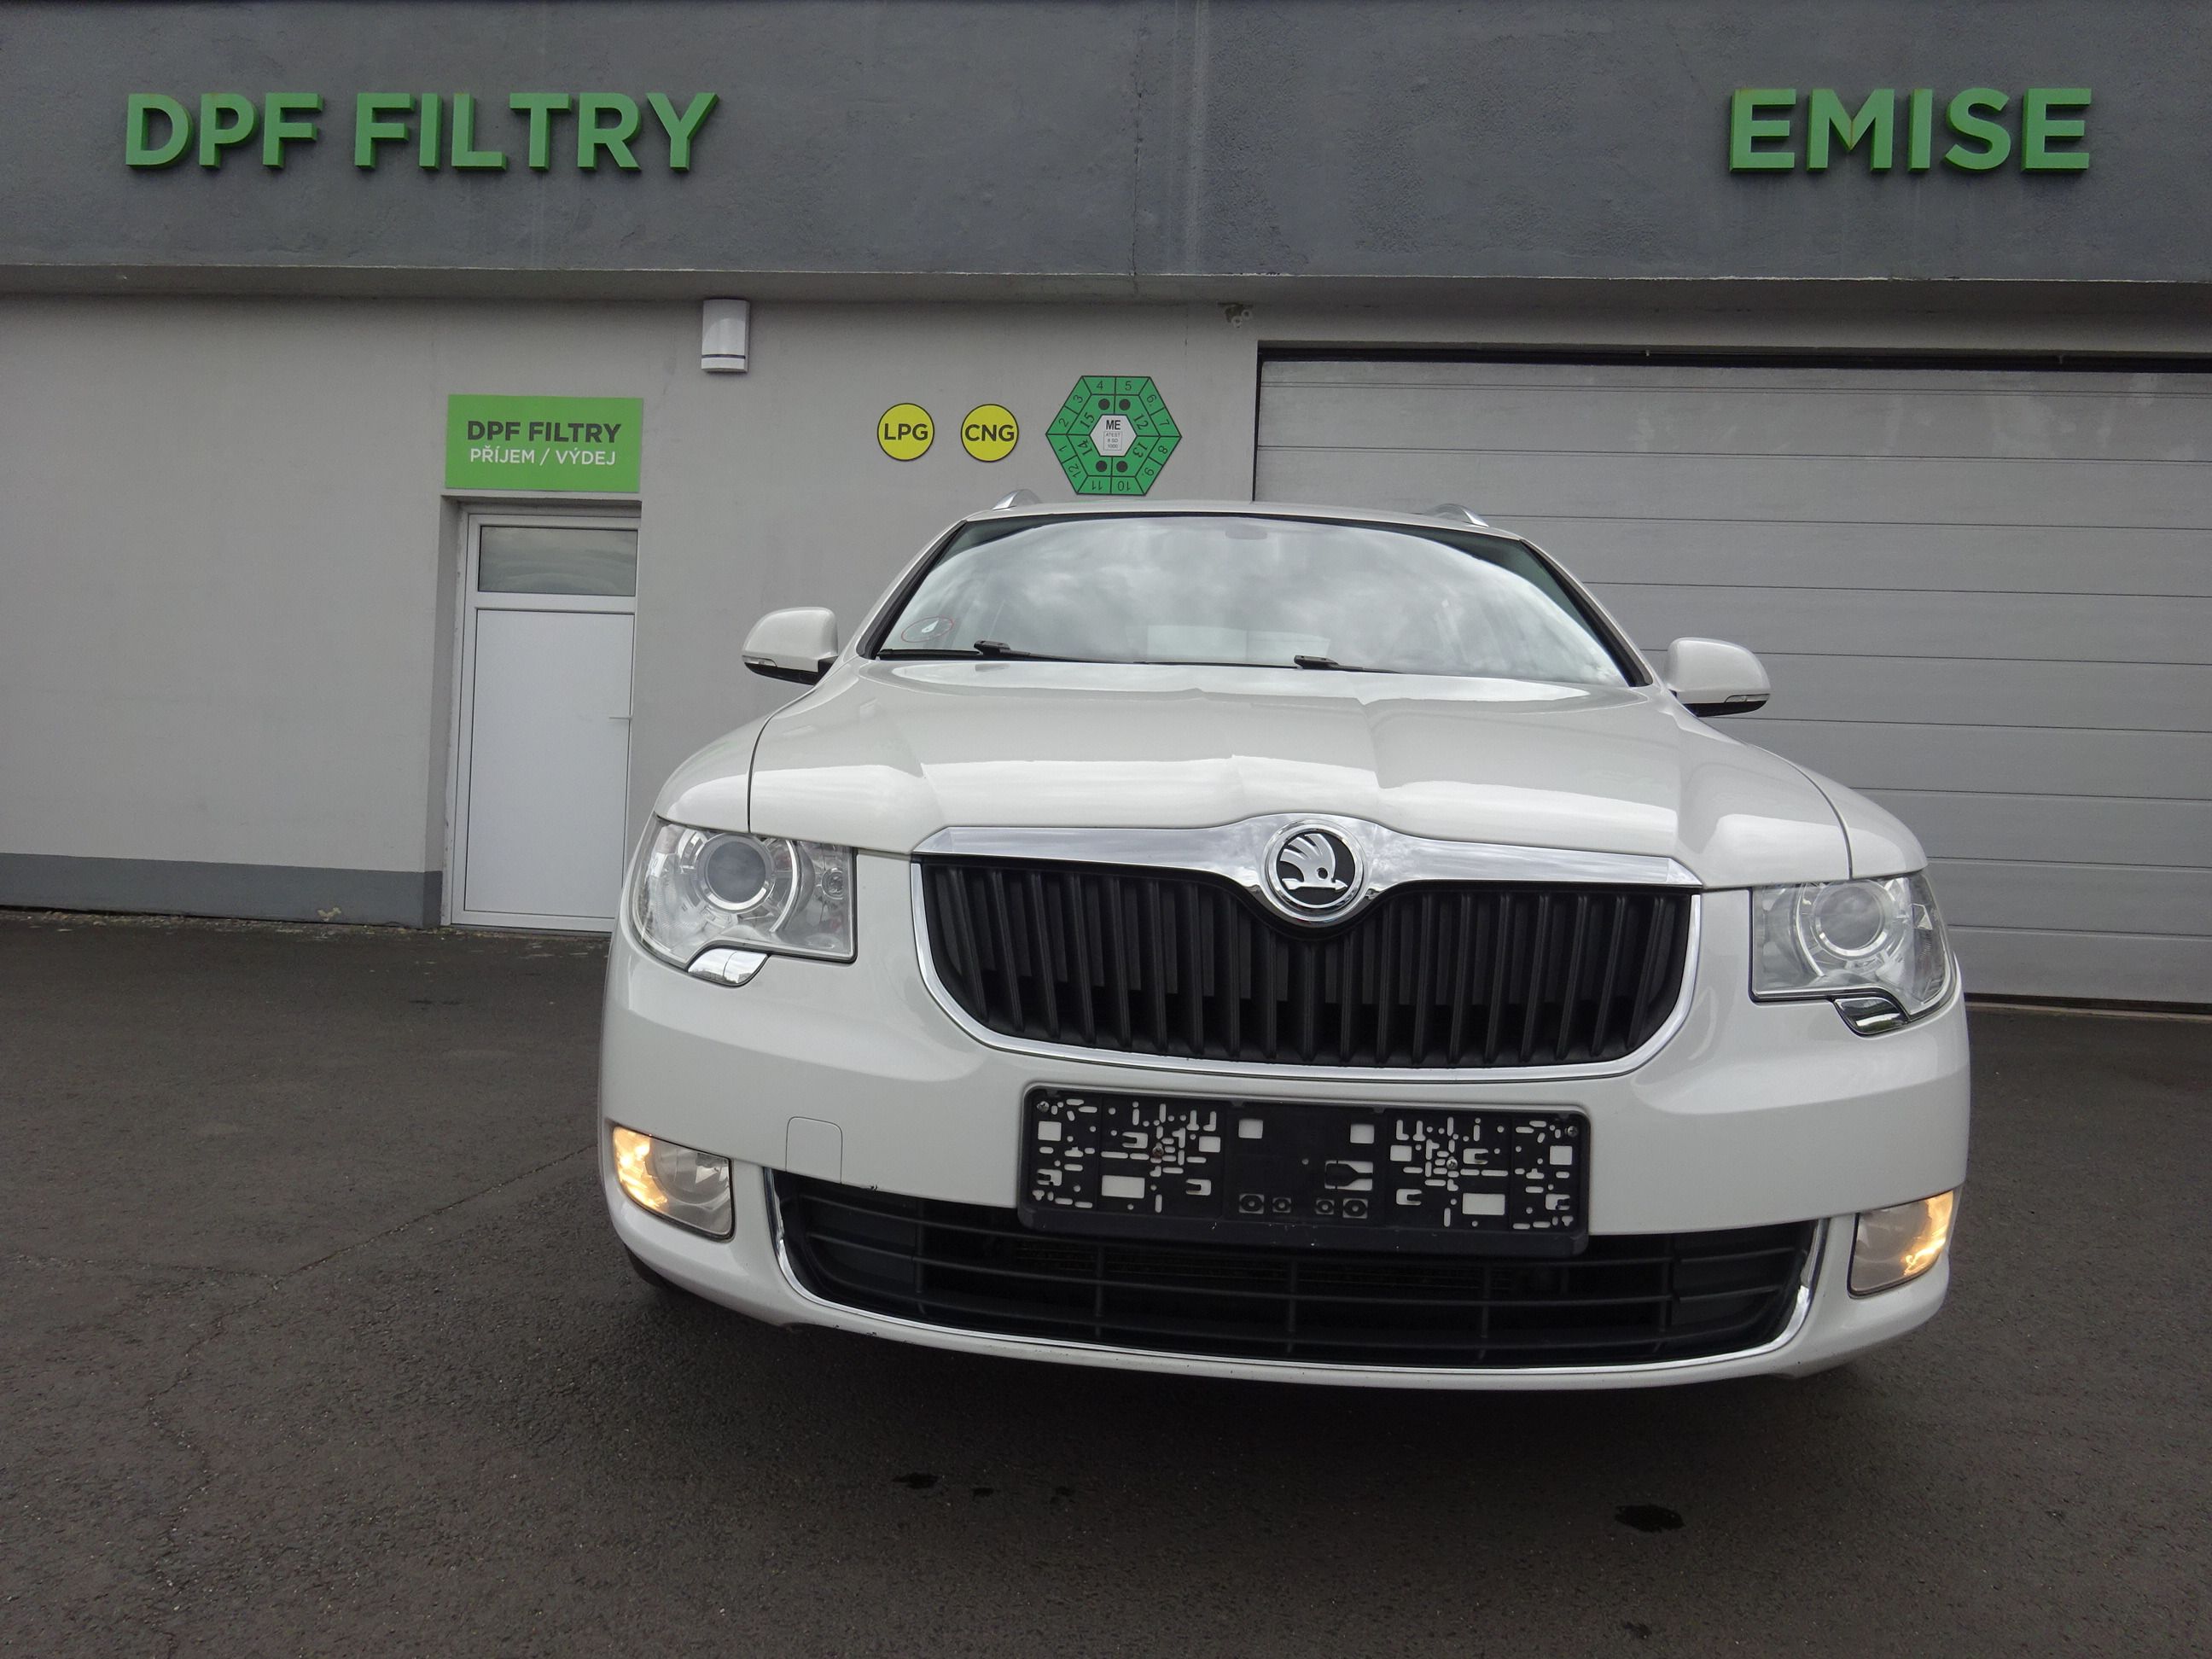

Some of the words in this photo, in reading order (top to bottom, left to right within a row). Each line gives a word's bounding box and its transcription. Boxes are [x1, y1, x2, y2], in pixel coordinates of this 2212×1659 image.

[126, 91, 323, 170] DPF
[354, 91, 720, 171] FILTRY
[1730, 87, 2092, 172] EMISE
[1096, 381, 1103, 390] 4
[1125, 381, 1132, 391] 5
[1073, 394, 1083, 403] 3
[1058, 417, 1069, 428] 2
[1080, 412, 1095, 429] 15
[1106, 419, 1121, 430] ME
[1133, 413, 1149, 430] 12
[1159, 419, 1170, 428] 7
[467, 420, 521, 441] DPF
[528, 422, 622, 443] FILTRY
[884, 423, 928, 441] LPG
[964, 424, 1015, 441] CNG
[1078, 439, 1092, 456] 14
[1132, 442, 1148, 457] 13
[1157, 445, 1168, 454] 8
[470, 445, 535, 463] PŘÍJEM
[539, 447, 550, 466] /
[556, 447, 616, 466] VÝDEJ
[1068, 463, 1081, 478] 12
[1091, 480, 1103, 491] 11
[1117, 480, 1131, 492] 10
